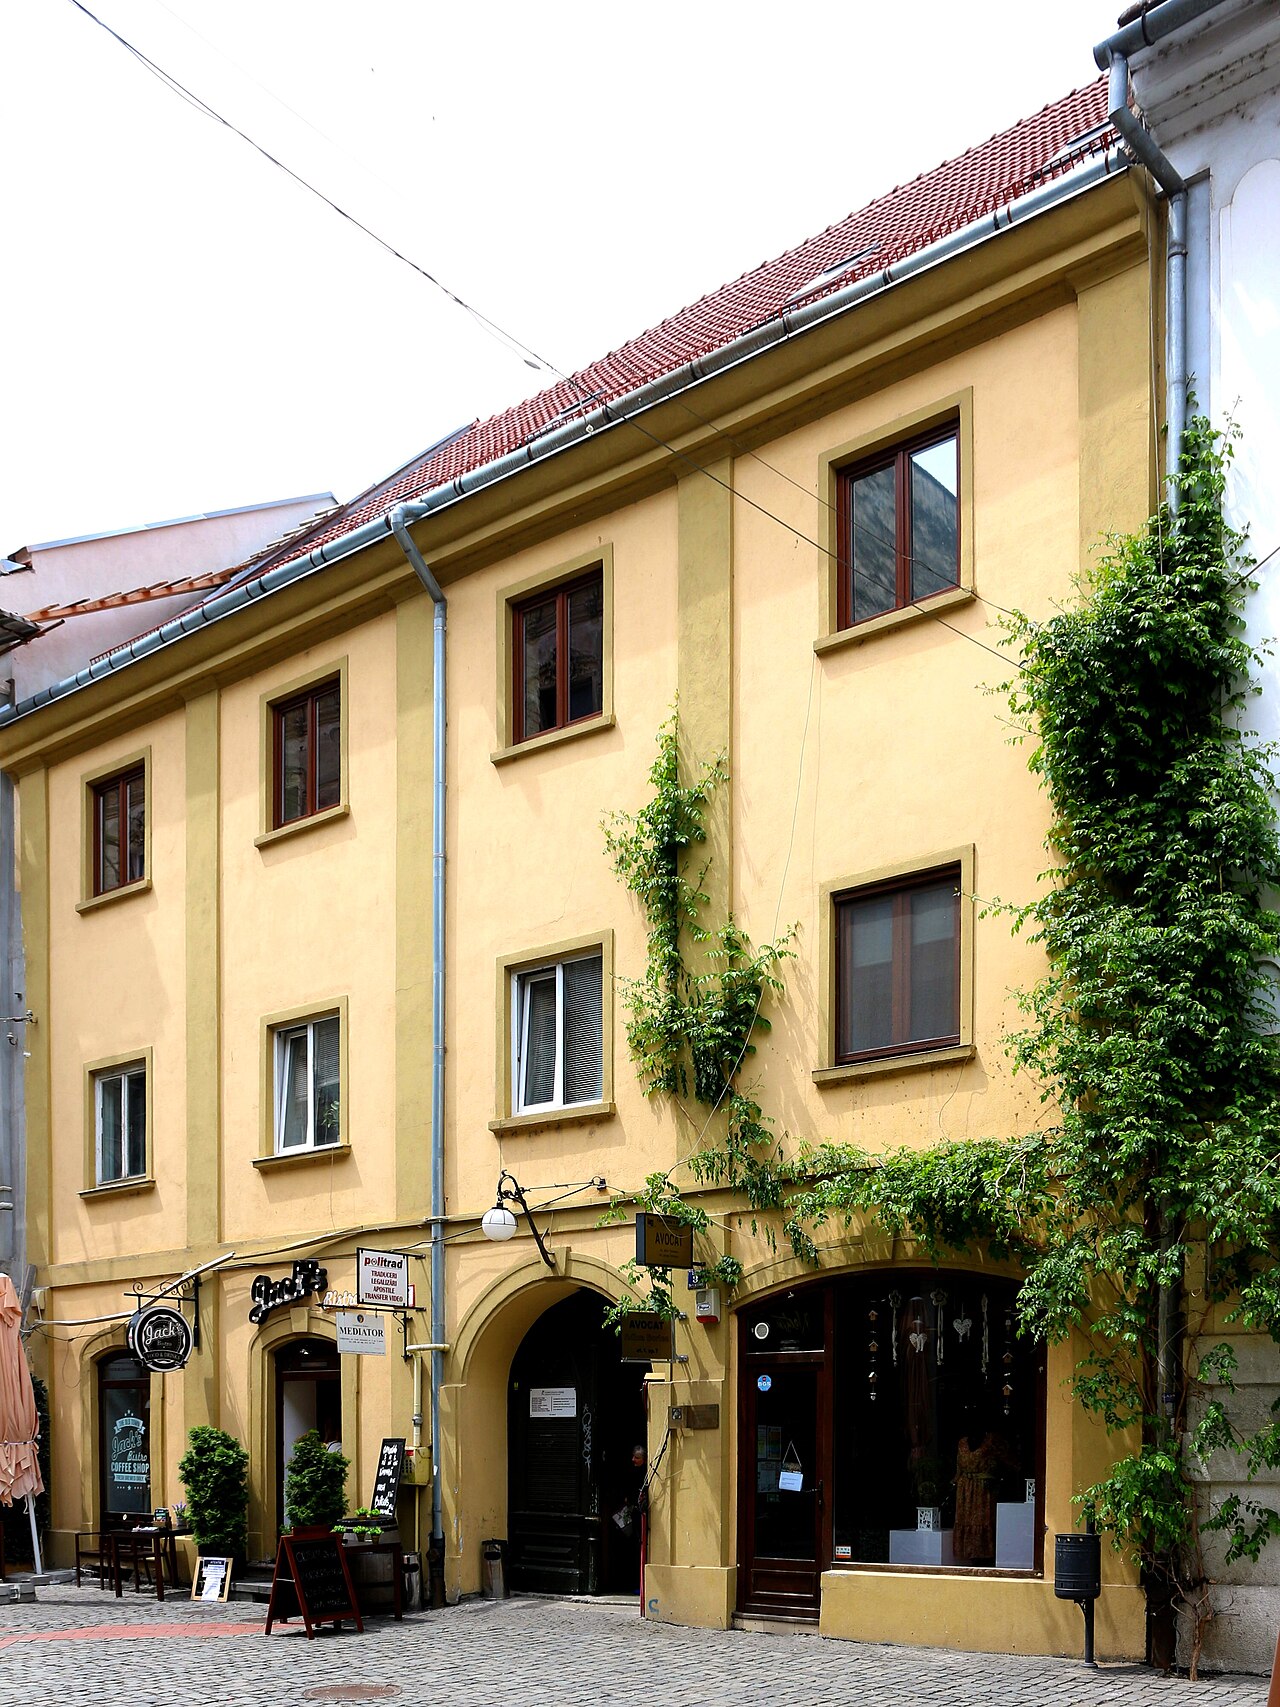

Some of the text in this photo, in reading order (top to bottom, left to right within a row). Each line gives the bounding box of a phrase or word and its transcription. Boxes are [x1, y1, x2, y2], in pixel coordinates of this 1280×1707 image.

[655, 1232, 683, 1247] AVOCAT
[364, 1257, 403, 1269] politrad
[371, 1270, 397, 1279] TRADUCERI
[373, 1286, 395, 1295] APOSTILE
[365, 1293, 404, 1303] TRANSFER VIDEO
[629, 1320, 664, 1330] AVOCAT
[145, 1321, 184, 1345] Jack's
[340, 1326, 384, 1337] MEDIATOR
[111, 1429, 143, 1461] Jack's
[111, 1461, 149, 1473] COFFEE SHOP
